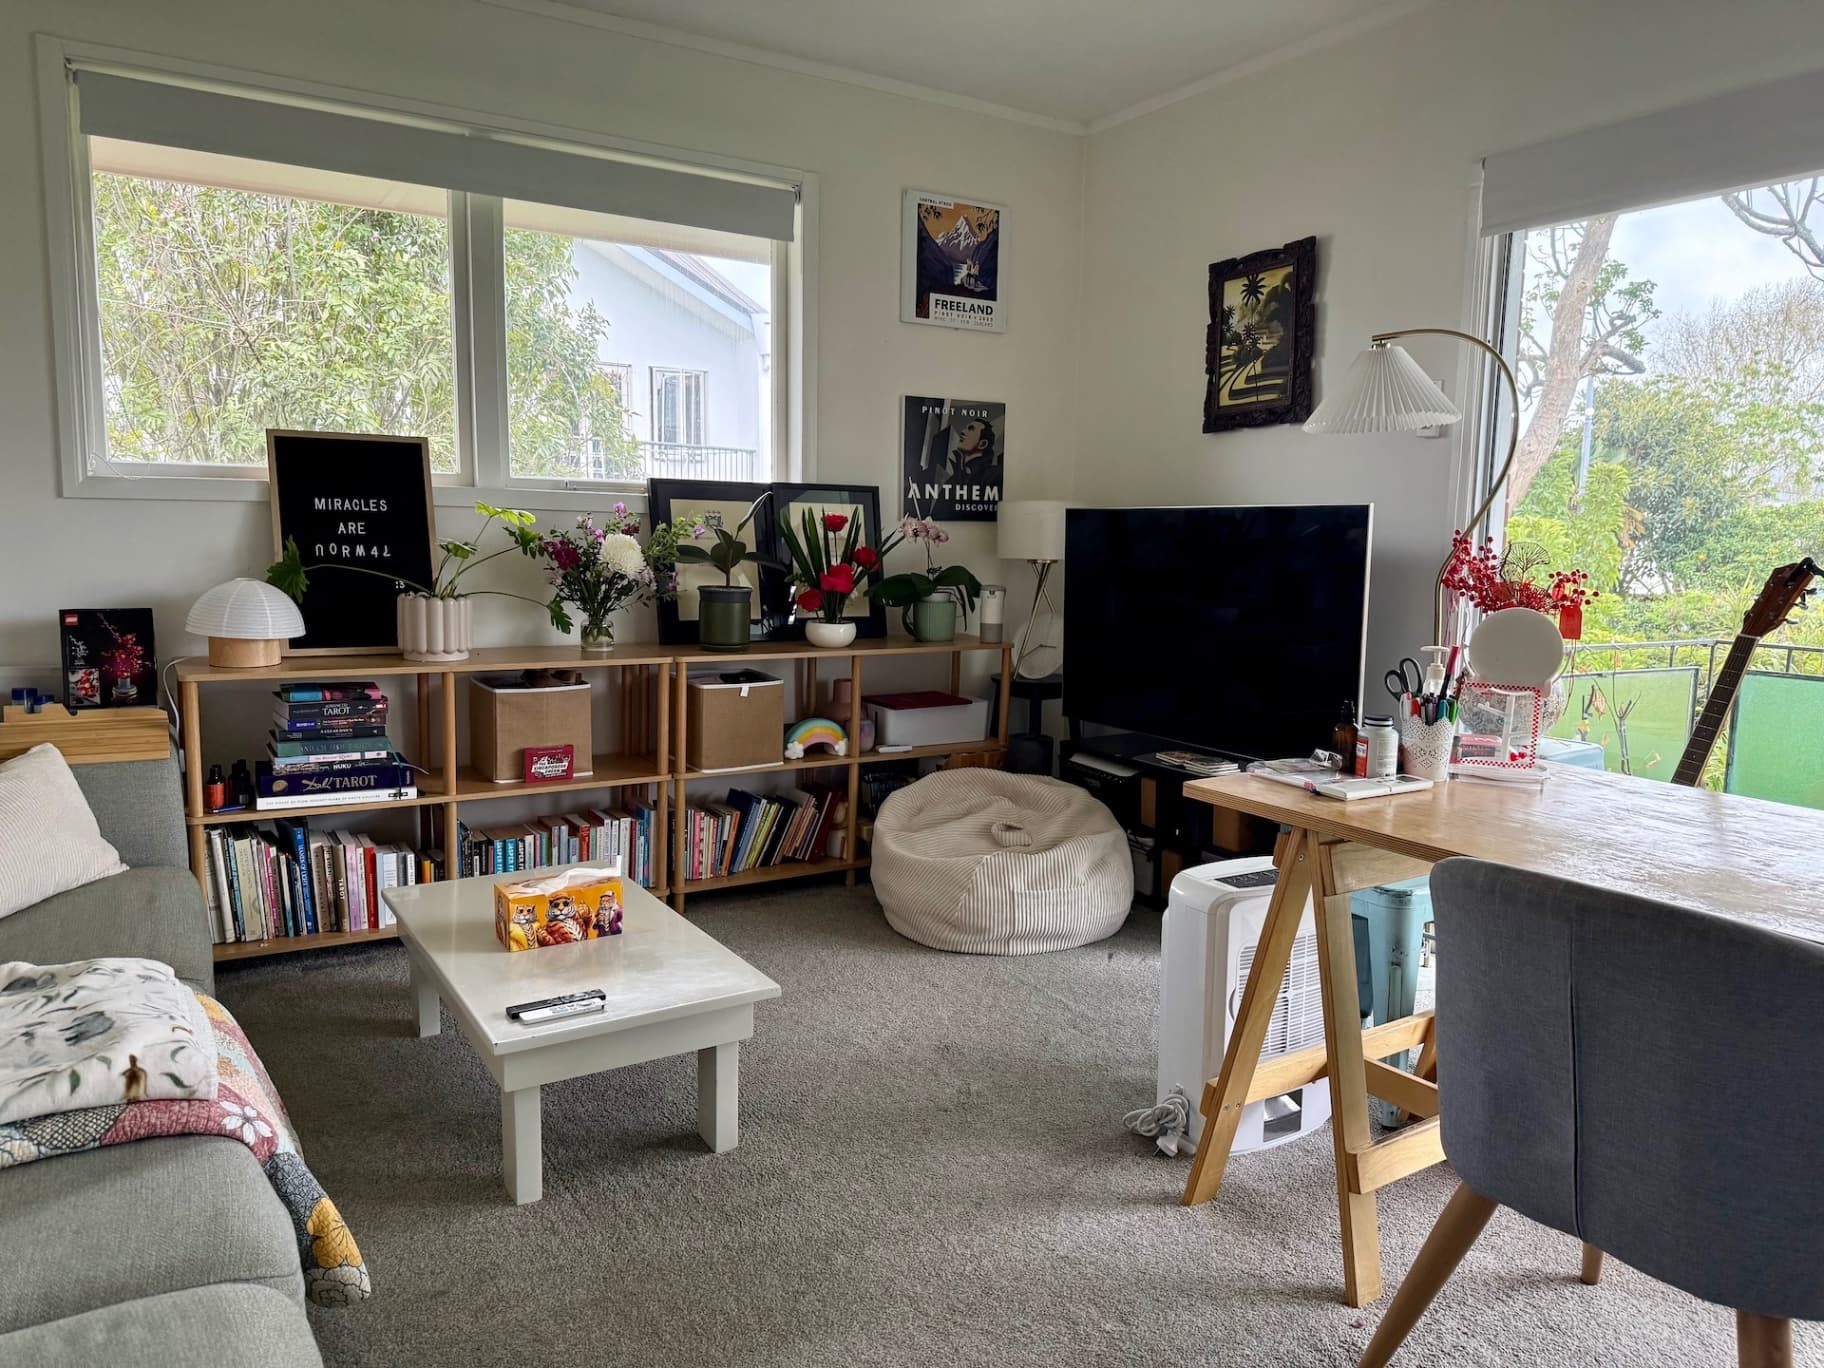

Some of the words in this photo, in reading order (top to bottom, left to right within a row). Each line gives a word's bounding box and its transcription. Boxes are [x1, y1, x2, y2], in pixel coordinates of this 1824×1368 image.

[934, 298, 994, 315] FREELAND
[922, 406, 955, 416] PINOT
[961, 409, 988, 418] NOIR
[907, 483, 999, 501] ANTHEM
[314, 497, 388, 511] MIRACLES
[338, 522, 366, 534] ARE
[322, 707, 350, 716] TAROT
[333, 775, 377, 788] TAROT
